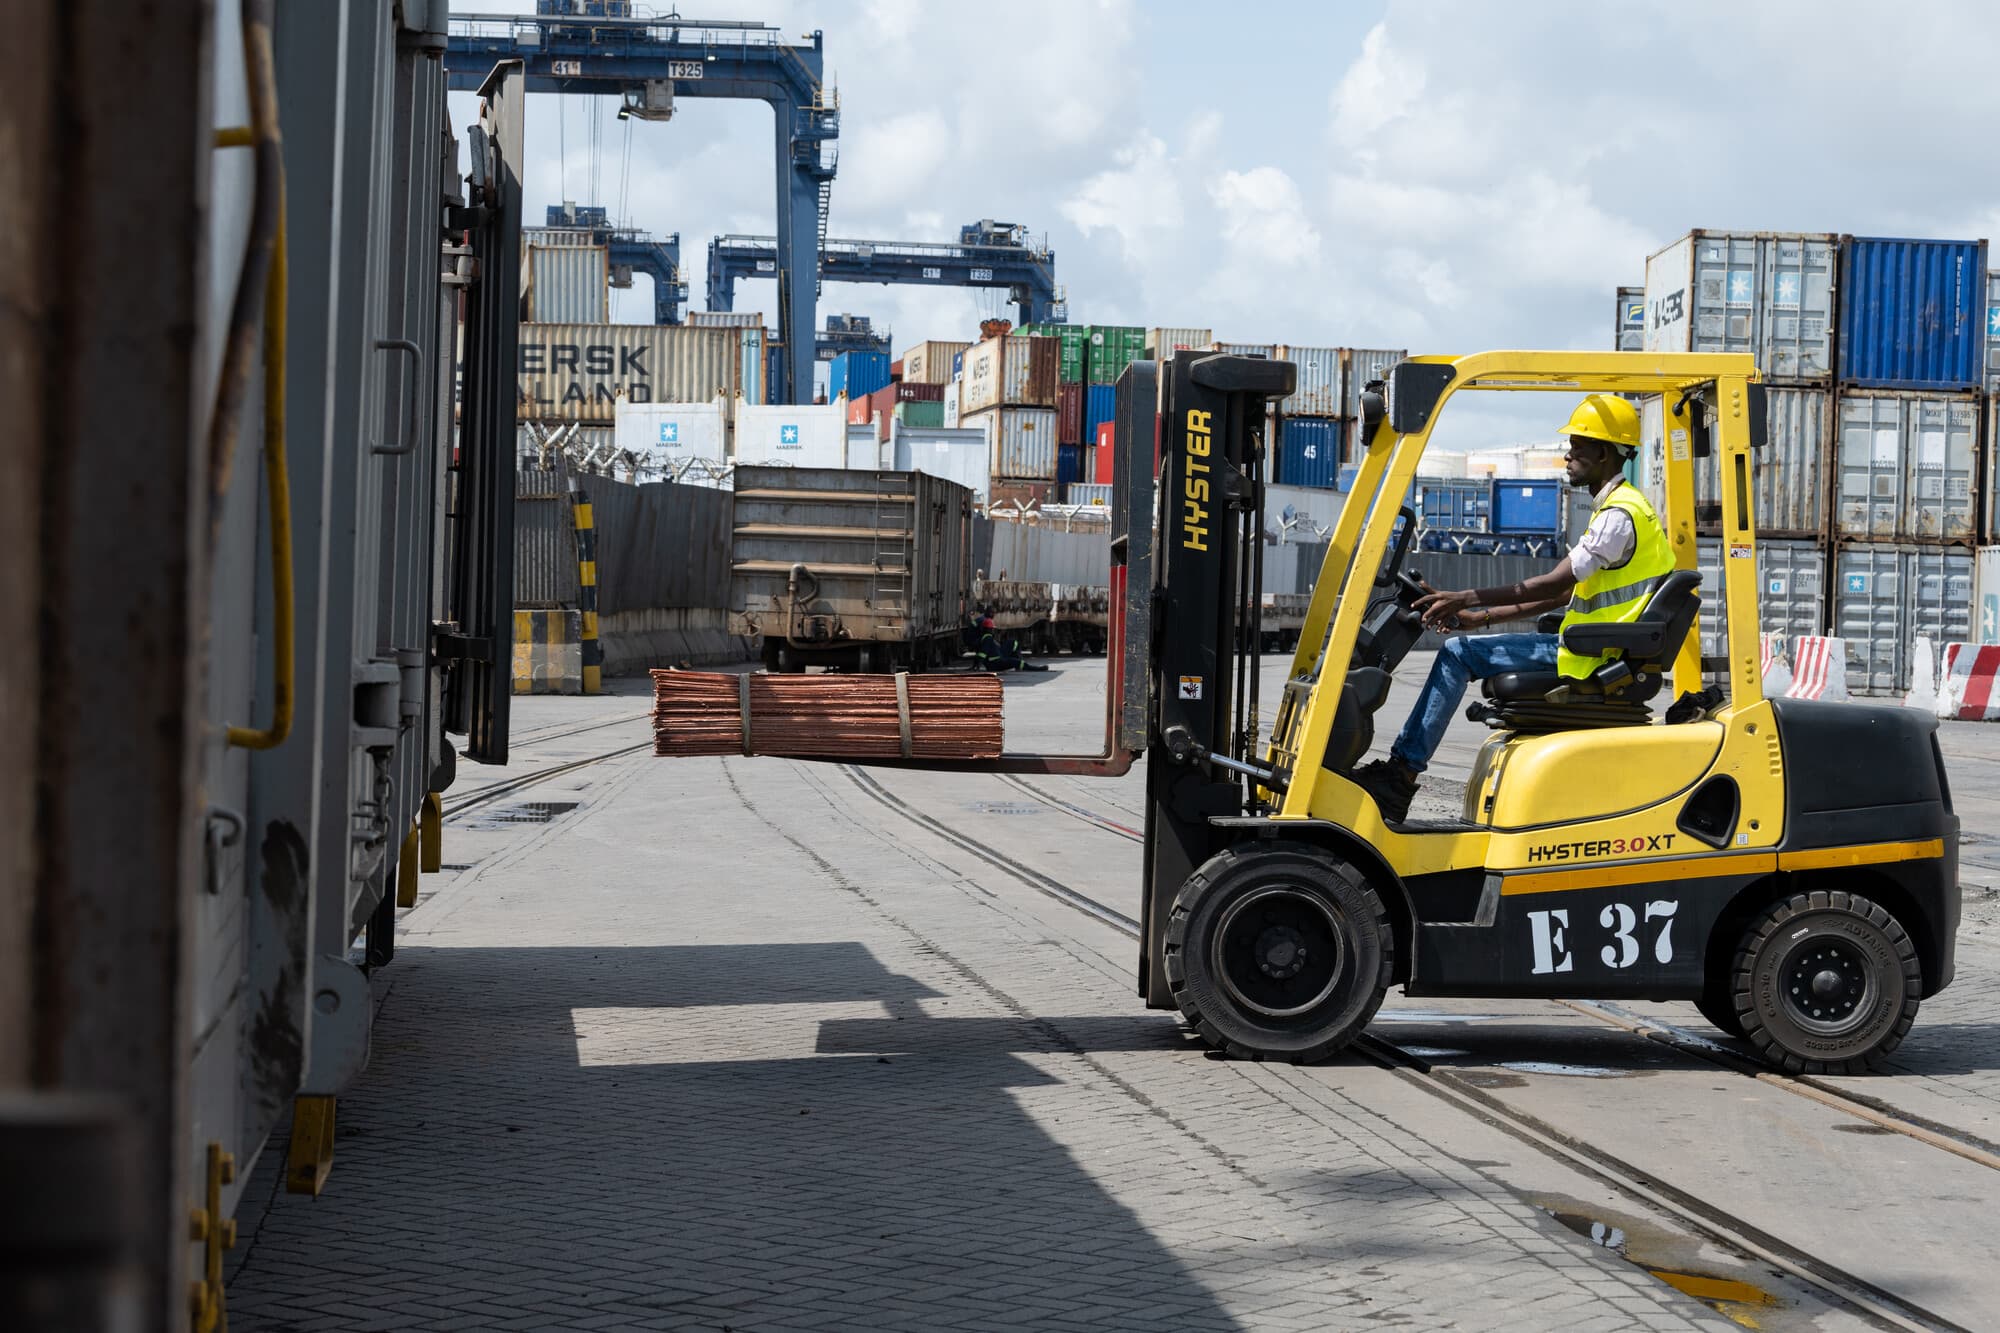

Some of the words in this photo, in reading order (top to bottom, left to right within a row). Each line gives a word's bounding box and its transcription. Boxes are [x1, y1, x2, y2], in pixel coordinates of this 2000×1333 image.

[670, 62, 702, 77] T325
[518, 343, 651, 376] ERSK
[1304, 445, 1317, 460] 45
[1183, 409, 1212, 552] HYSTER
[1527, 909, 1574, 975] E
[1599, 900, 1679, 969] 37
